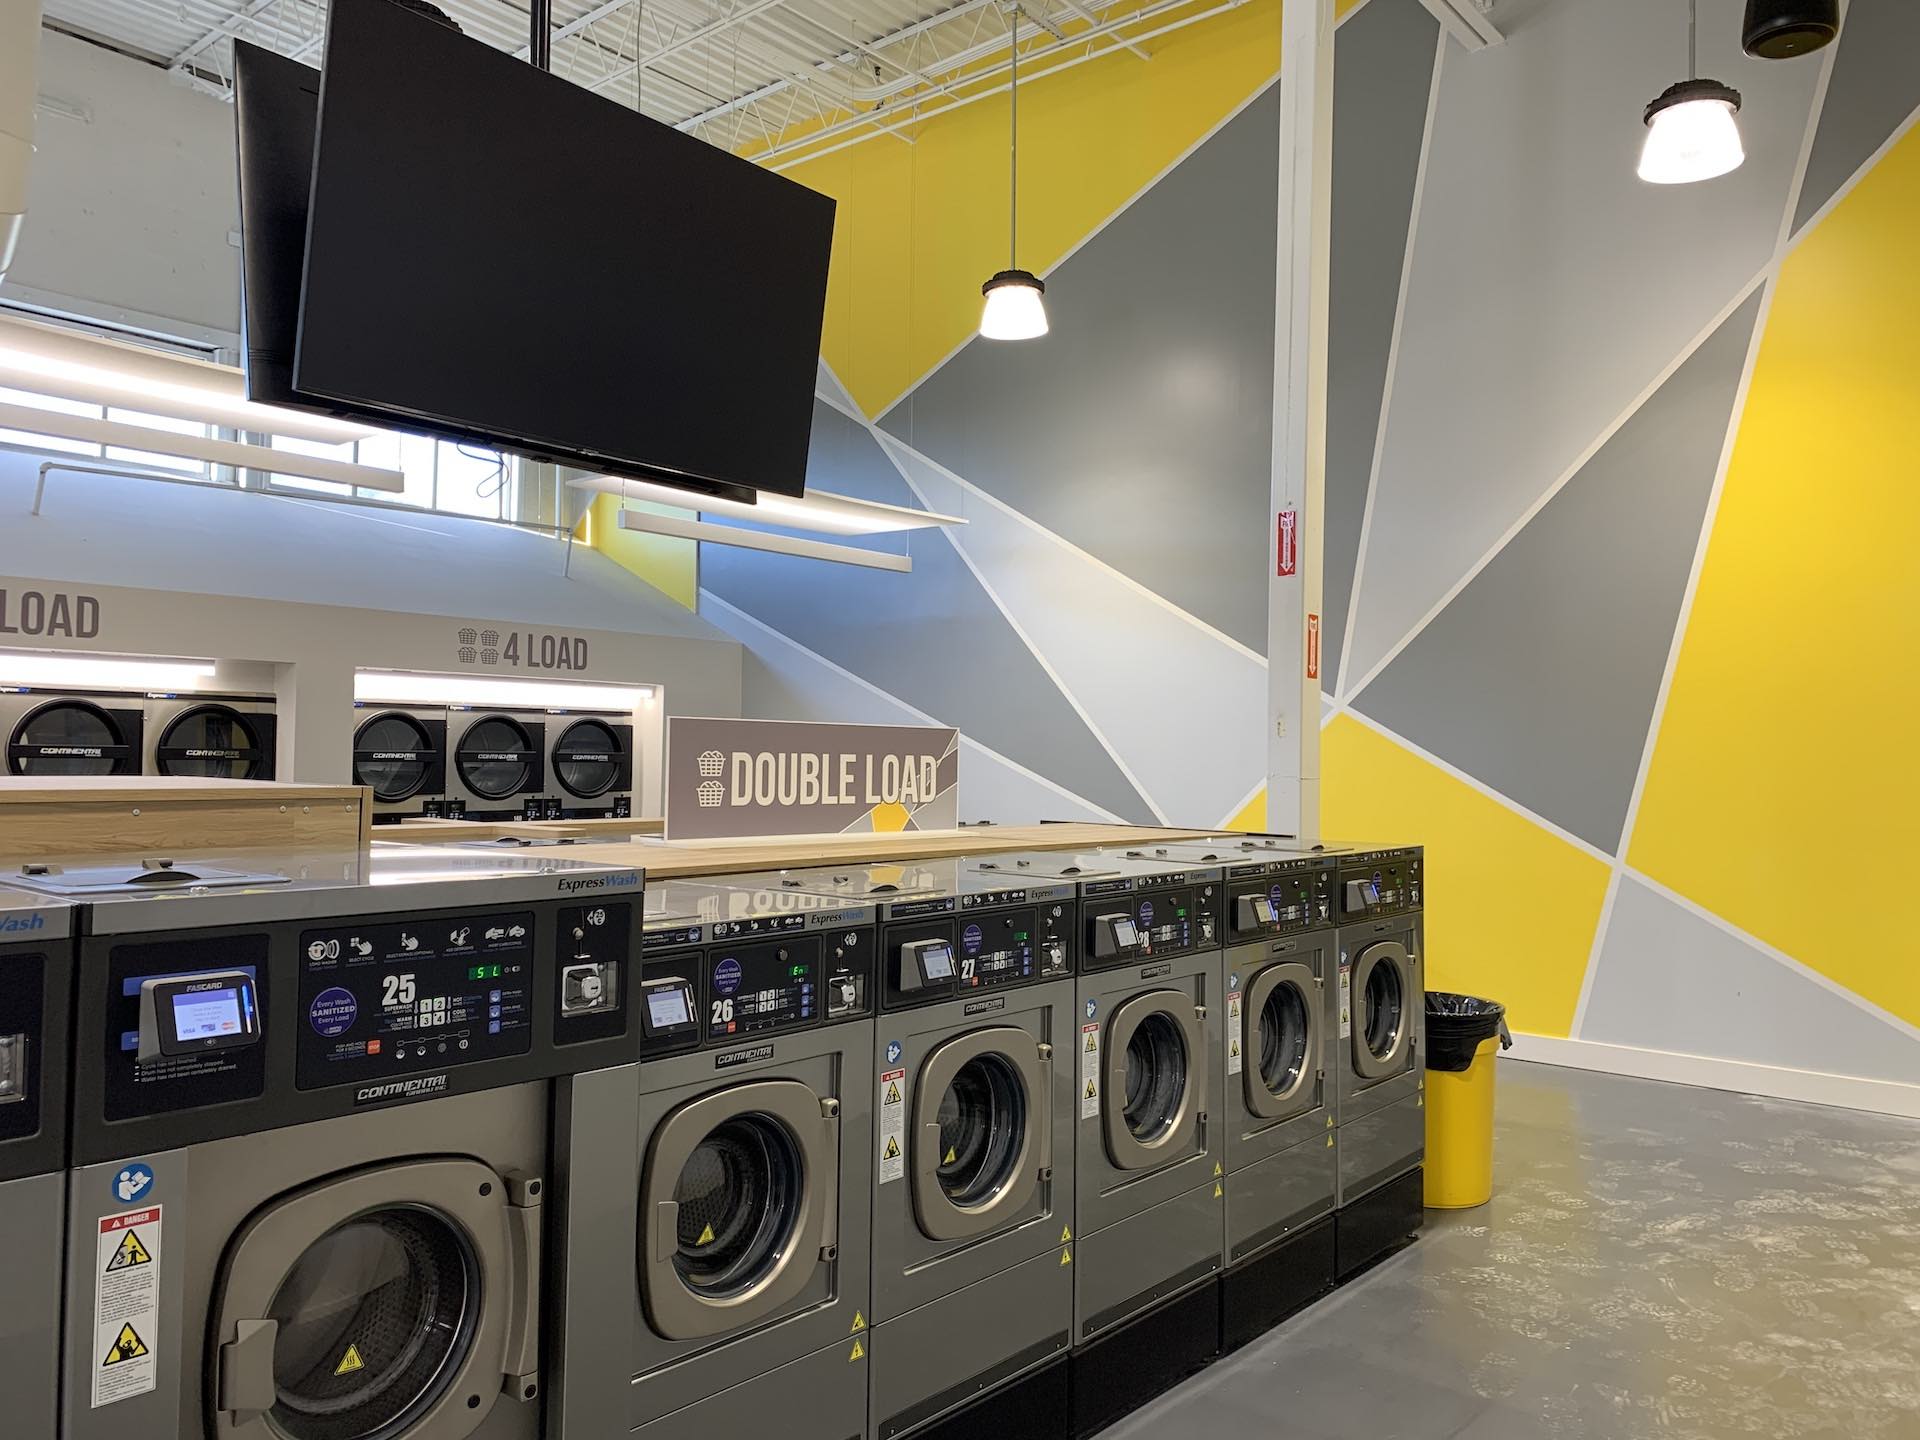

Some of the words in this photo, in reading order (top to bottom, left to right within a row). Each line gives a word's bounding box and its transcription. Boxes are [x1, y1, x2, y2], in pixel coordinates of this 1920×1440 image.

[0, 589, 99, 638] LOAD
[504, 632, 520, 666] 4
[528, 634, 588, 670] LOAD
[730, 751, 857, 807] DOUBLE
[865, 753, 938, 805] LOAD
[557, 872, 638, 893] ExpressWash
[0, 913, 44, 930] ash
[962, 959, 976, 980] 27
[186, 982, 223, 992] FASCARD
[381, 974, 416, 1006] 25
[312, 1005, 355, 1018] SANITIZED
[437, 1001, 443, 1009] 2
[711, 998, 734, 1024] 26
[335, 1014, 350, 1022] Load
[717, 1046, 772, 1064] CONTINENTAL
[357, 1075, 447, 1100] CONTINENTAL
[124, 1212, 150, 1226] DANGER
